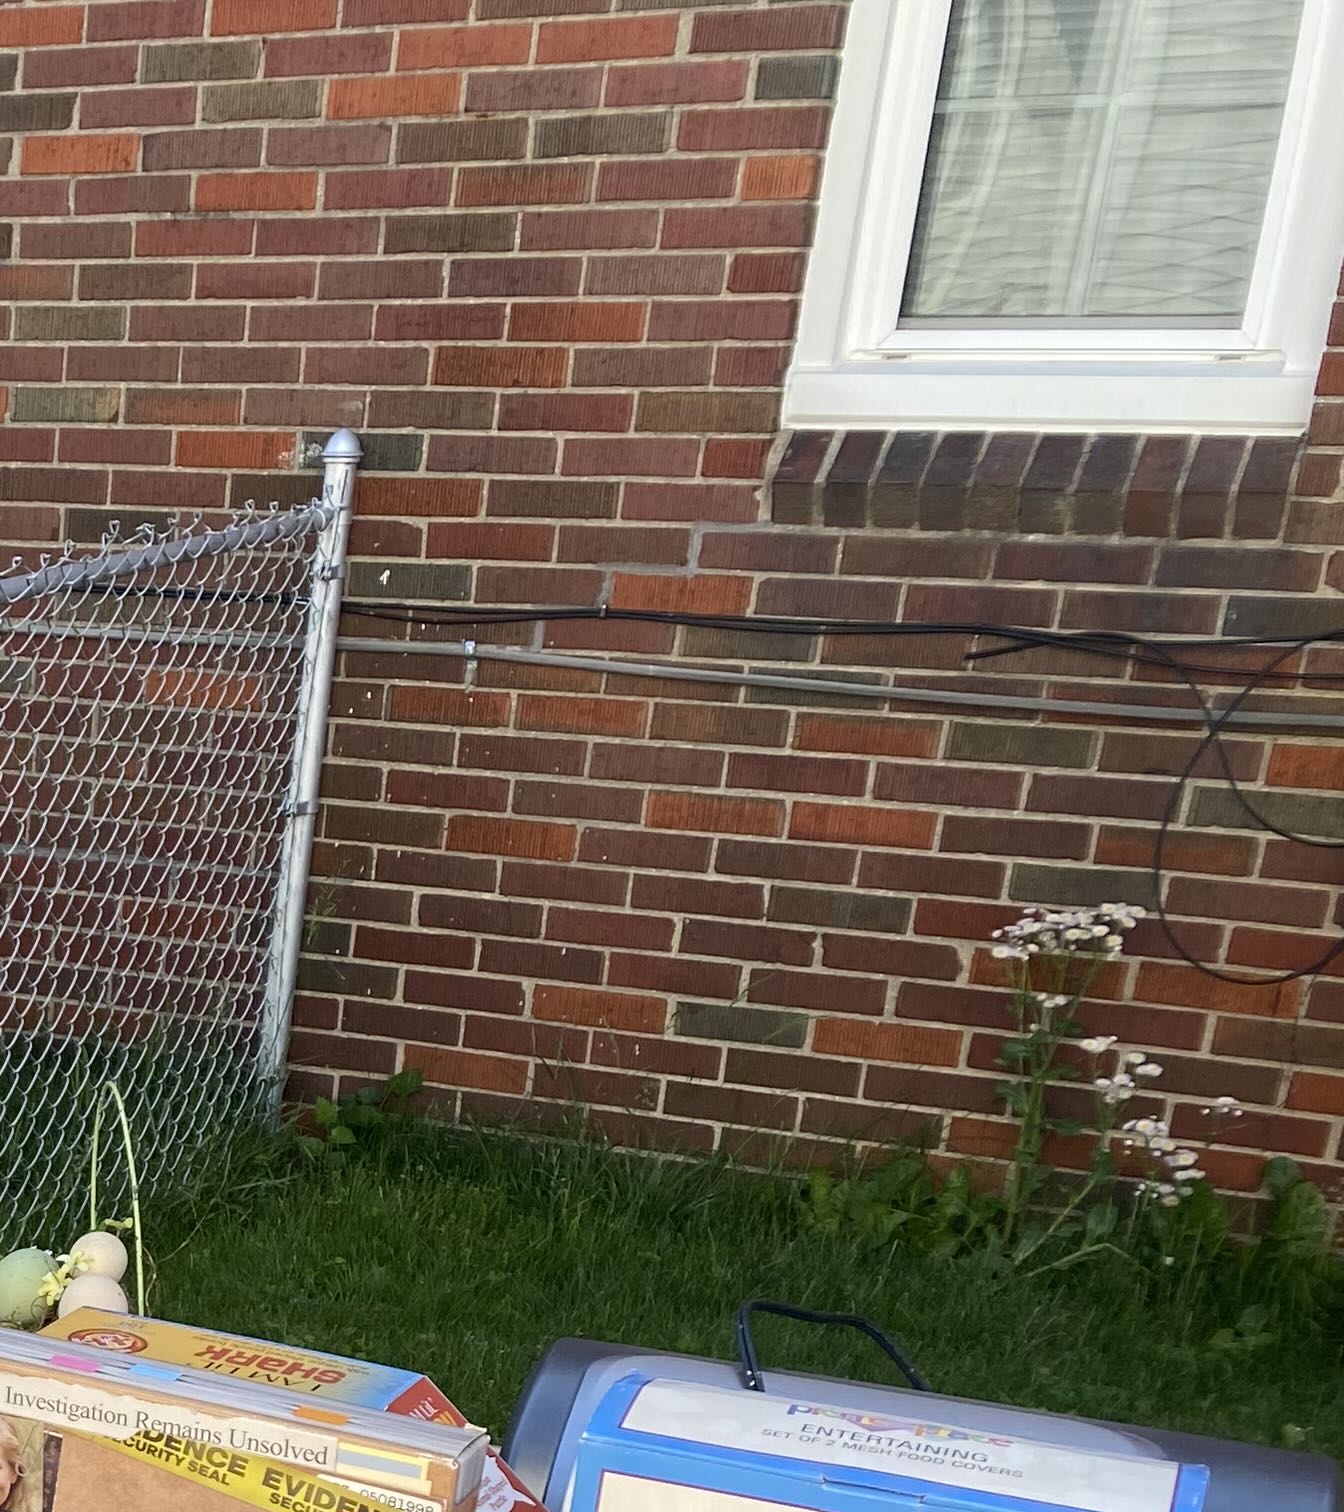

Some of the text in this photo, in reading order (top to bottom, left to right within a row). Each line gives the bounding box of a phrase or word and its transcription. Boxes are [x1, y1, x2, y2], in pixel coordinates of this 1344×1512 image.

[5, 1385, 130, 1428] Investigation
[135, 1410, 223, 1443] Remains
[229, 1427, 328, 1466] Unsolved
[799, 1423, 990, 1463] ENTERTAINING
[187, 1460, 230, 1486] SEAL
[761, 1428, 792, 1440] SET
[798, 1434, 821, 1444] OF
[842, 1442, 898, 1458] MESH
[898, 1450, 946, 1466] FOOD
[951, 1459, 1025, 1478] COVERS
